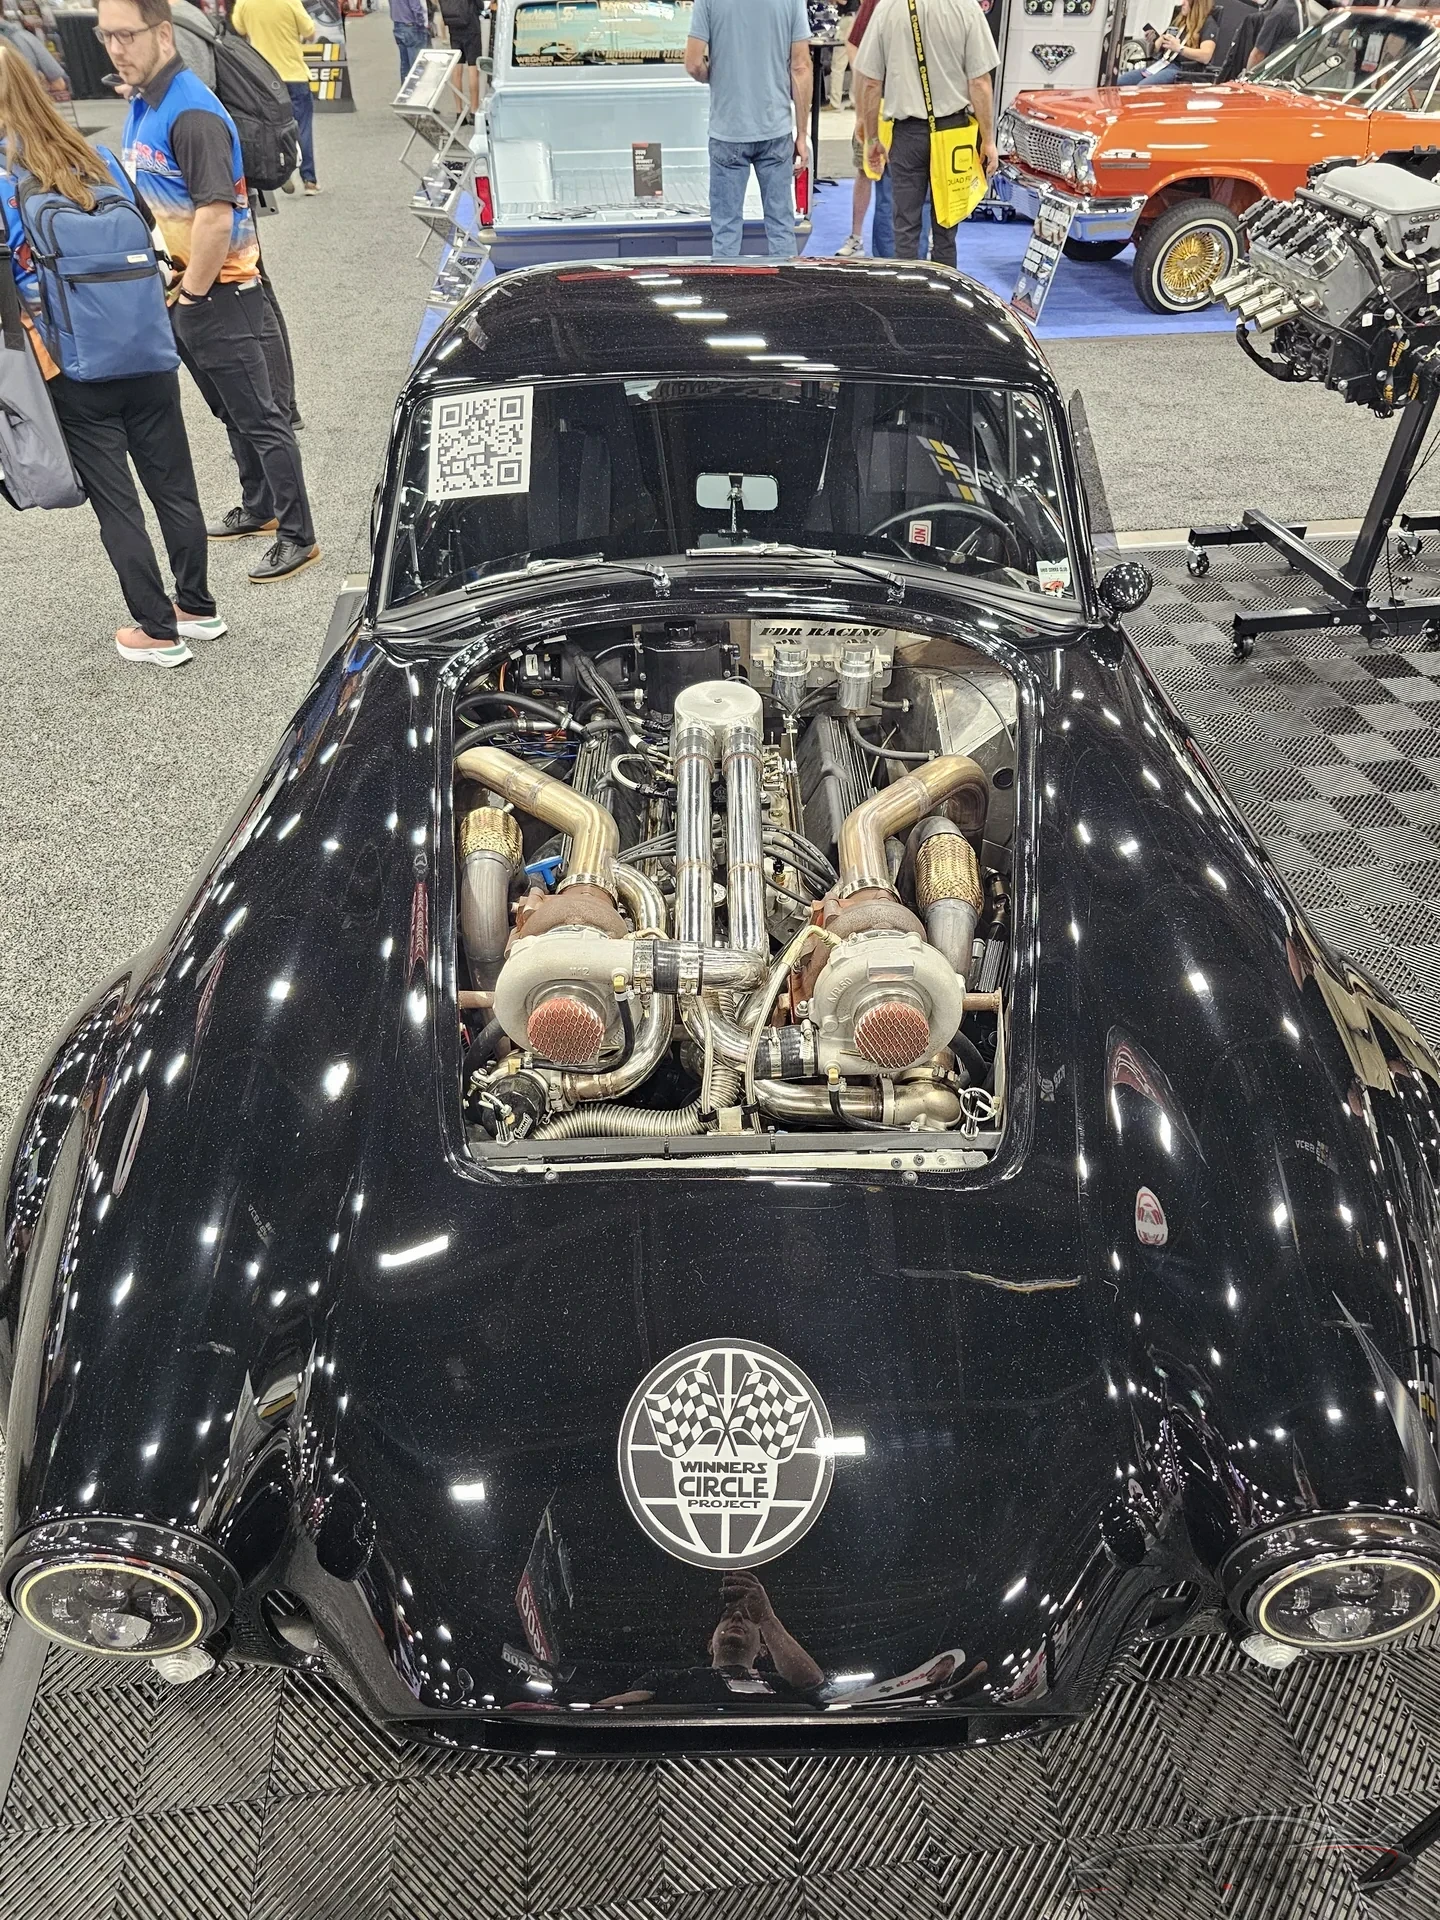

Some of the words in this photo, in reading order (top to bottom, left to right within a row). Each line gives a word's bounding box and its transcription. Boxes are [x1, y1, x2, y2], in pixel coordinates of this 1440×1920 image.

[759, 627, 803, 636] FDR
[806, 627, 887, 637] RACING
[680, 1461, 768, 1474] WINNERS
[678, 1476, 769, 1498] CIRCLE
[687, 1500, 761, 1509] PROJECT
